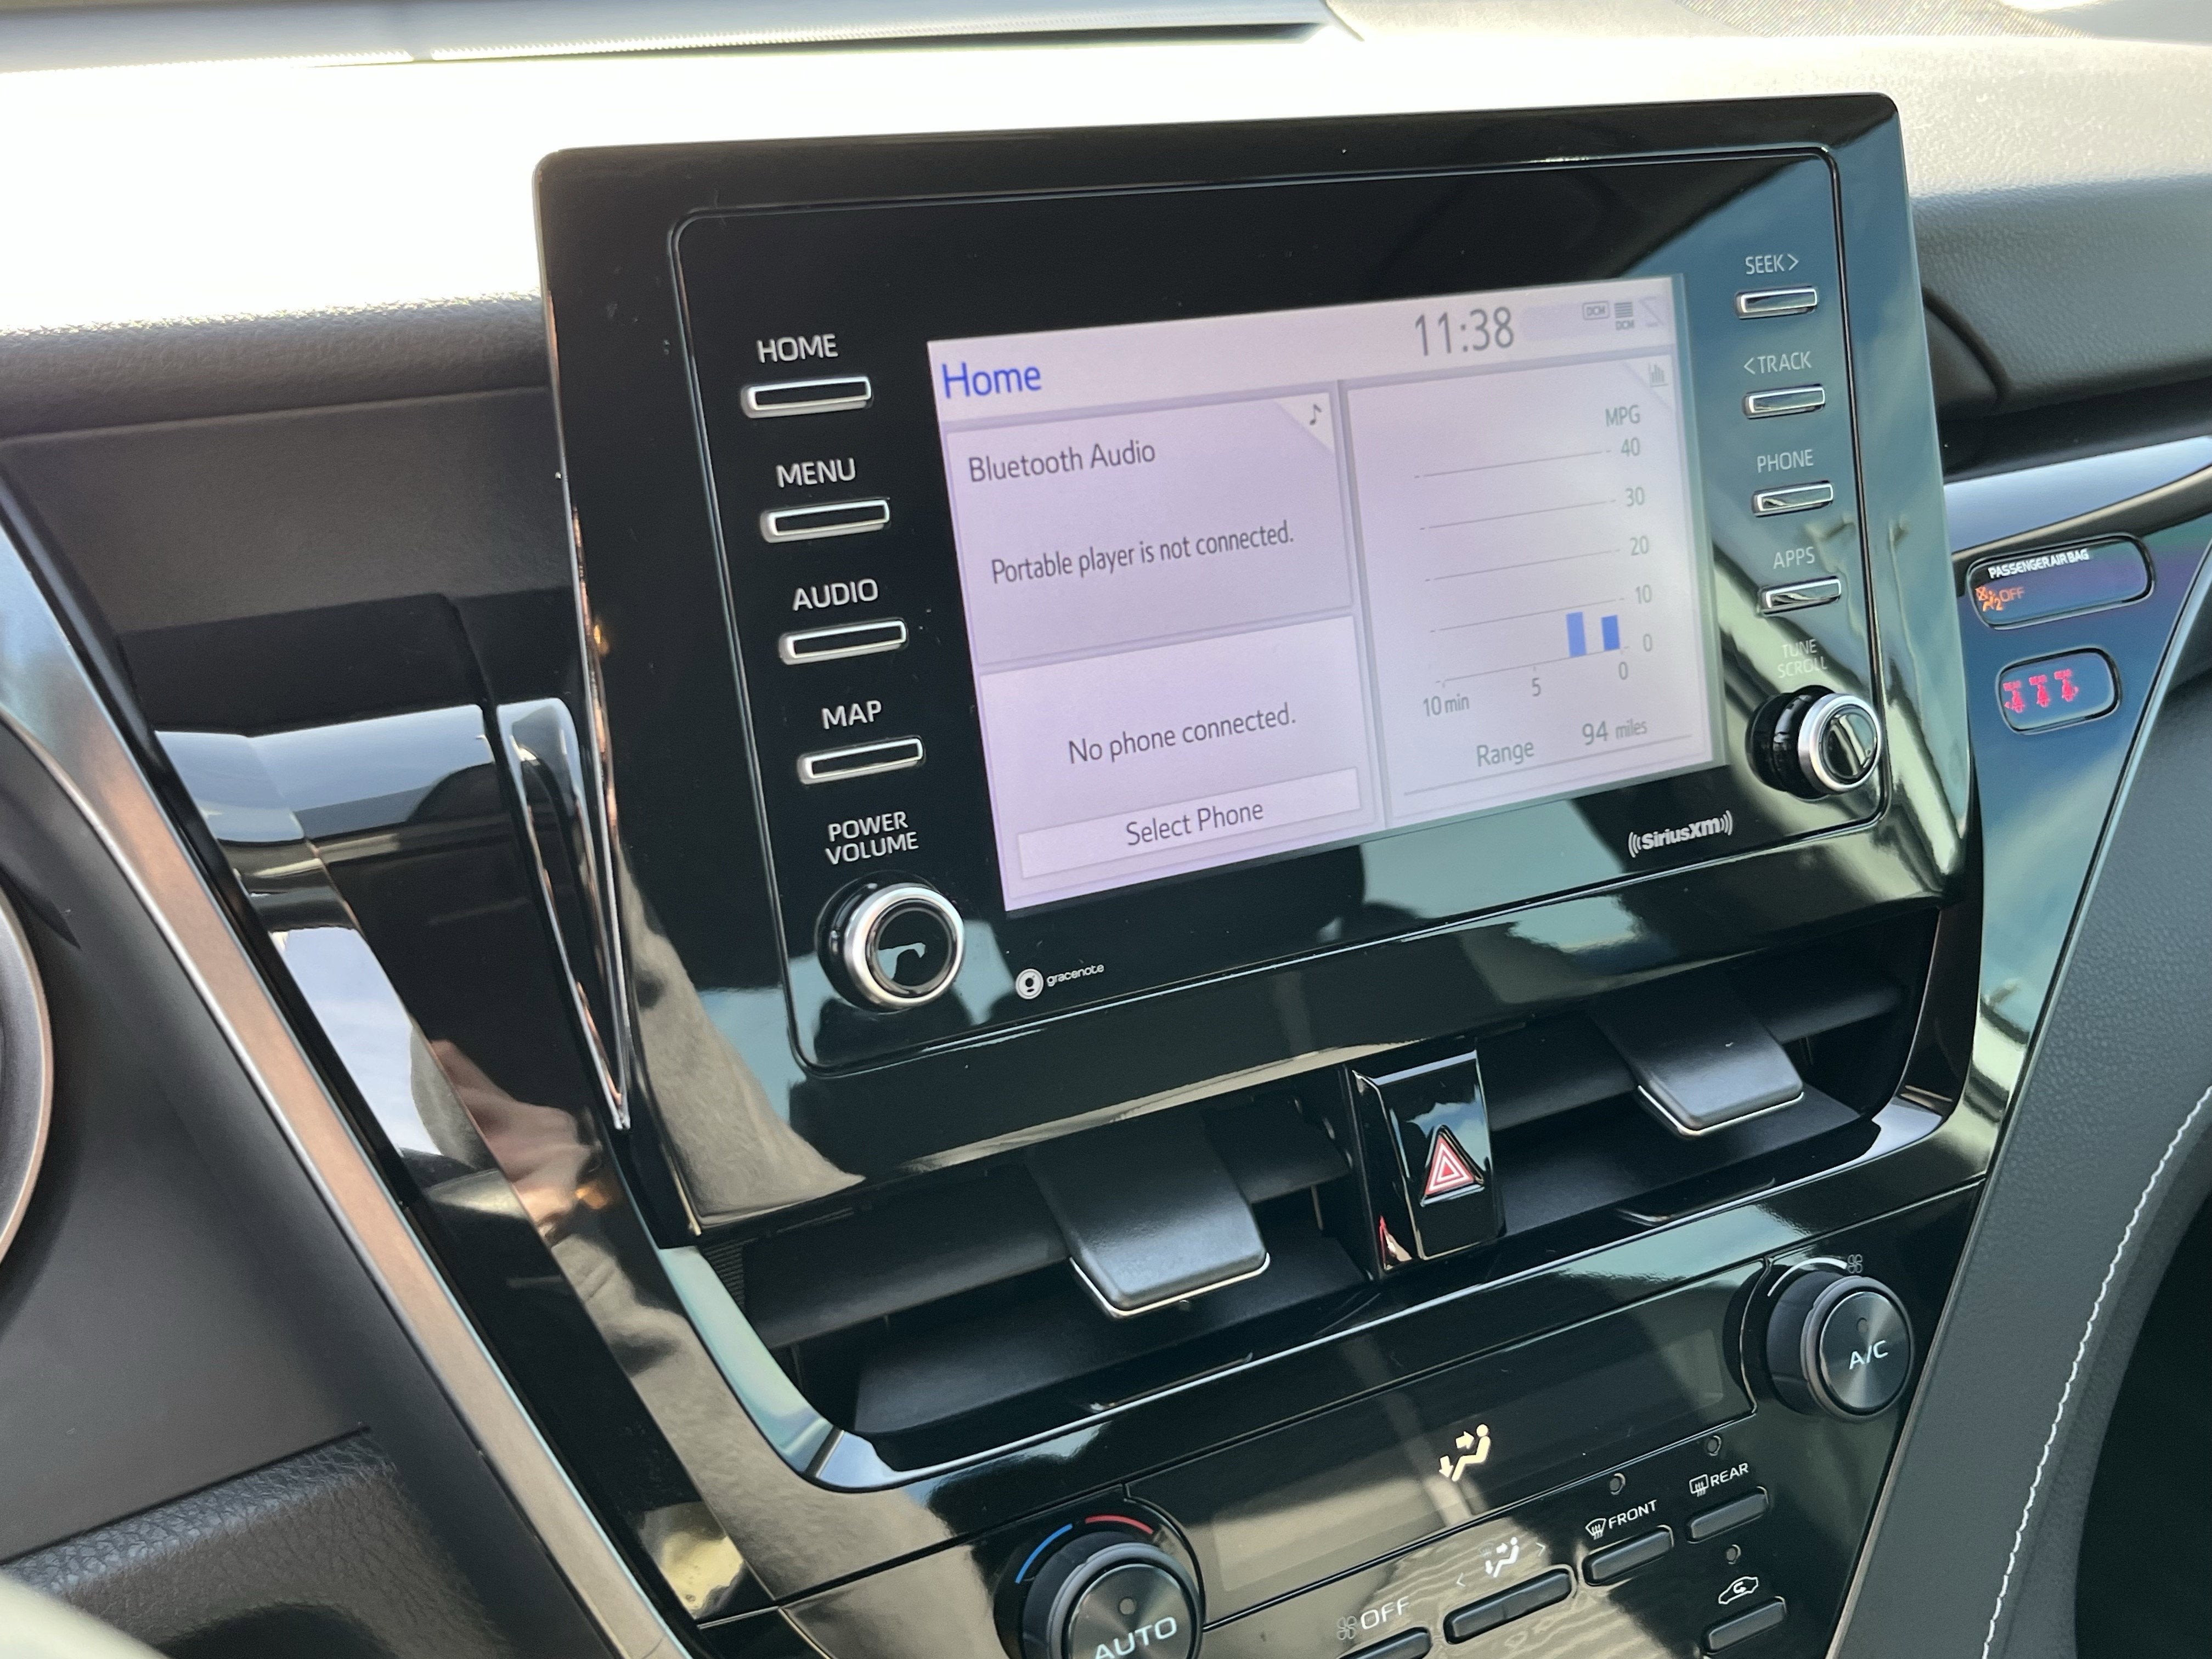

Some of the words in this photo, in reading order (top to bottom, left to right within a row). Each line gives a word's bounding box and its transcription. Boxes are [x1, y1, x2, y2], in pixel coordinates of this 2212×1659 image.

[1414, 306, 1514, 357] 11:38
[757, 334, 838, 363] HOME
[941, 362, 1042, 399] Home
[1605, 404, 1640, 427] MPG
[1620, 437, 1641, 457] 40
[776, 458, 856, 488] MENU
[969, 447, 1083, 482] Bluetooth
[1091, 440, 1156, 469] Audio
[1757, 449, 1814, 473] PHONE
[1625, 487, 1645, 507] 30
[991, 550, 1073, 584] Portable
[1079, 546, 1135, 578] player
[1139, 540, 1154, 564] is
[1160, 536, 1191, 561] not
[1195, 520, 1295, 555] connected.
[1629, 535, 1649, 556] 20
[1773, 546, 1815, 569] APPS
[792, 578, 878, 611] AUDIO
[1635, 584, 1652, 604] 10
[1999, 586, 2024, 602] OFF
[1643, 633, 1653, 652] 0
[1782, 639, 1818, 658] TUNE
[1618, 661, 1628, 680] 0
[1778, 656, 1828, 679] SCROLL
[1531, 677, 1541, 697] 5
[821, 700, 882, 730] MAP
[1423, 696, 1442, 718] 10
[1444, 693, 1470, 714] min
[1068, 738, 1103, 764] No
[1109, 731, 1176, 763] phone
[1182, 702, 1296, 743] connected.
[1582, 721, 1609, 746] 94
[1615, 719, 1647, 740] miles
[1476, 741, 1534, 768] Range
[828, 811, 909, 842] POWER
[1126, 814, 1192, 846] Select
[1197, 803, 1264, 832] Phone
[825, 831, 919, 865] VOLUME
[1046, 964, 1104, 987] gracenote
[1849, 1340, 1888, 1370] A/C
[1710, 1462, 1749, 1488] REAR
[1608, 1499, 1657, 1530] FRONT
[1360, 1596, 1410, 1631] OFF
[1094, 1616, 1177, 1659] AUTO
